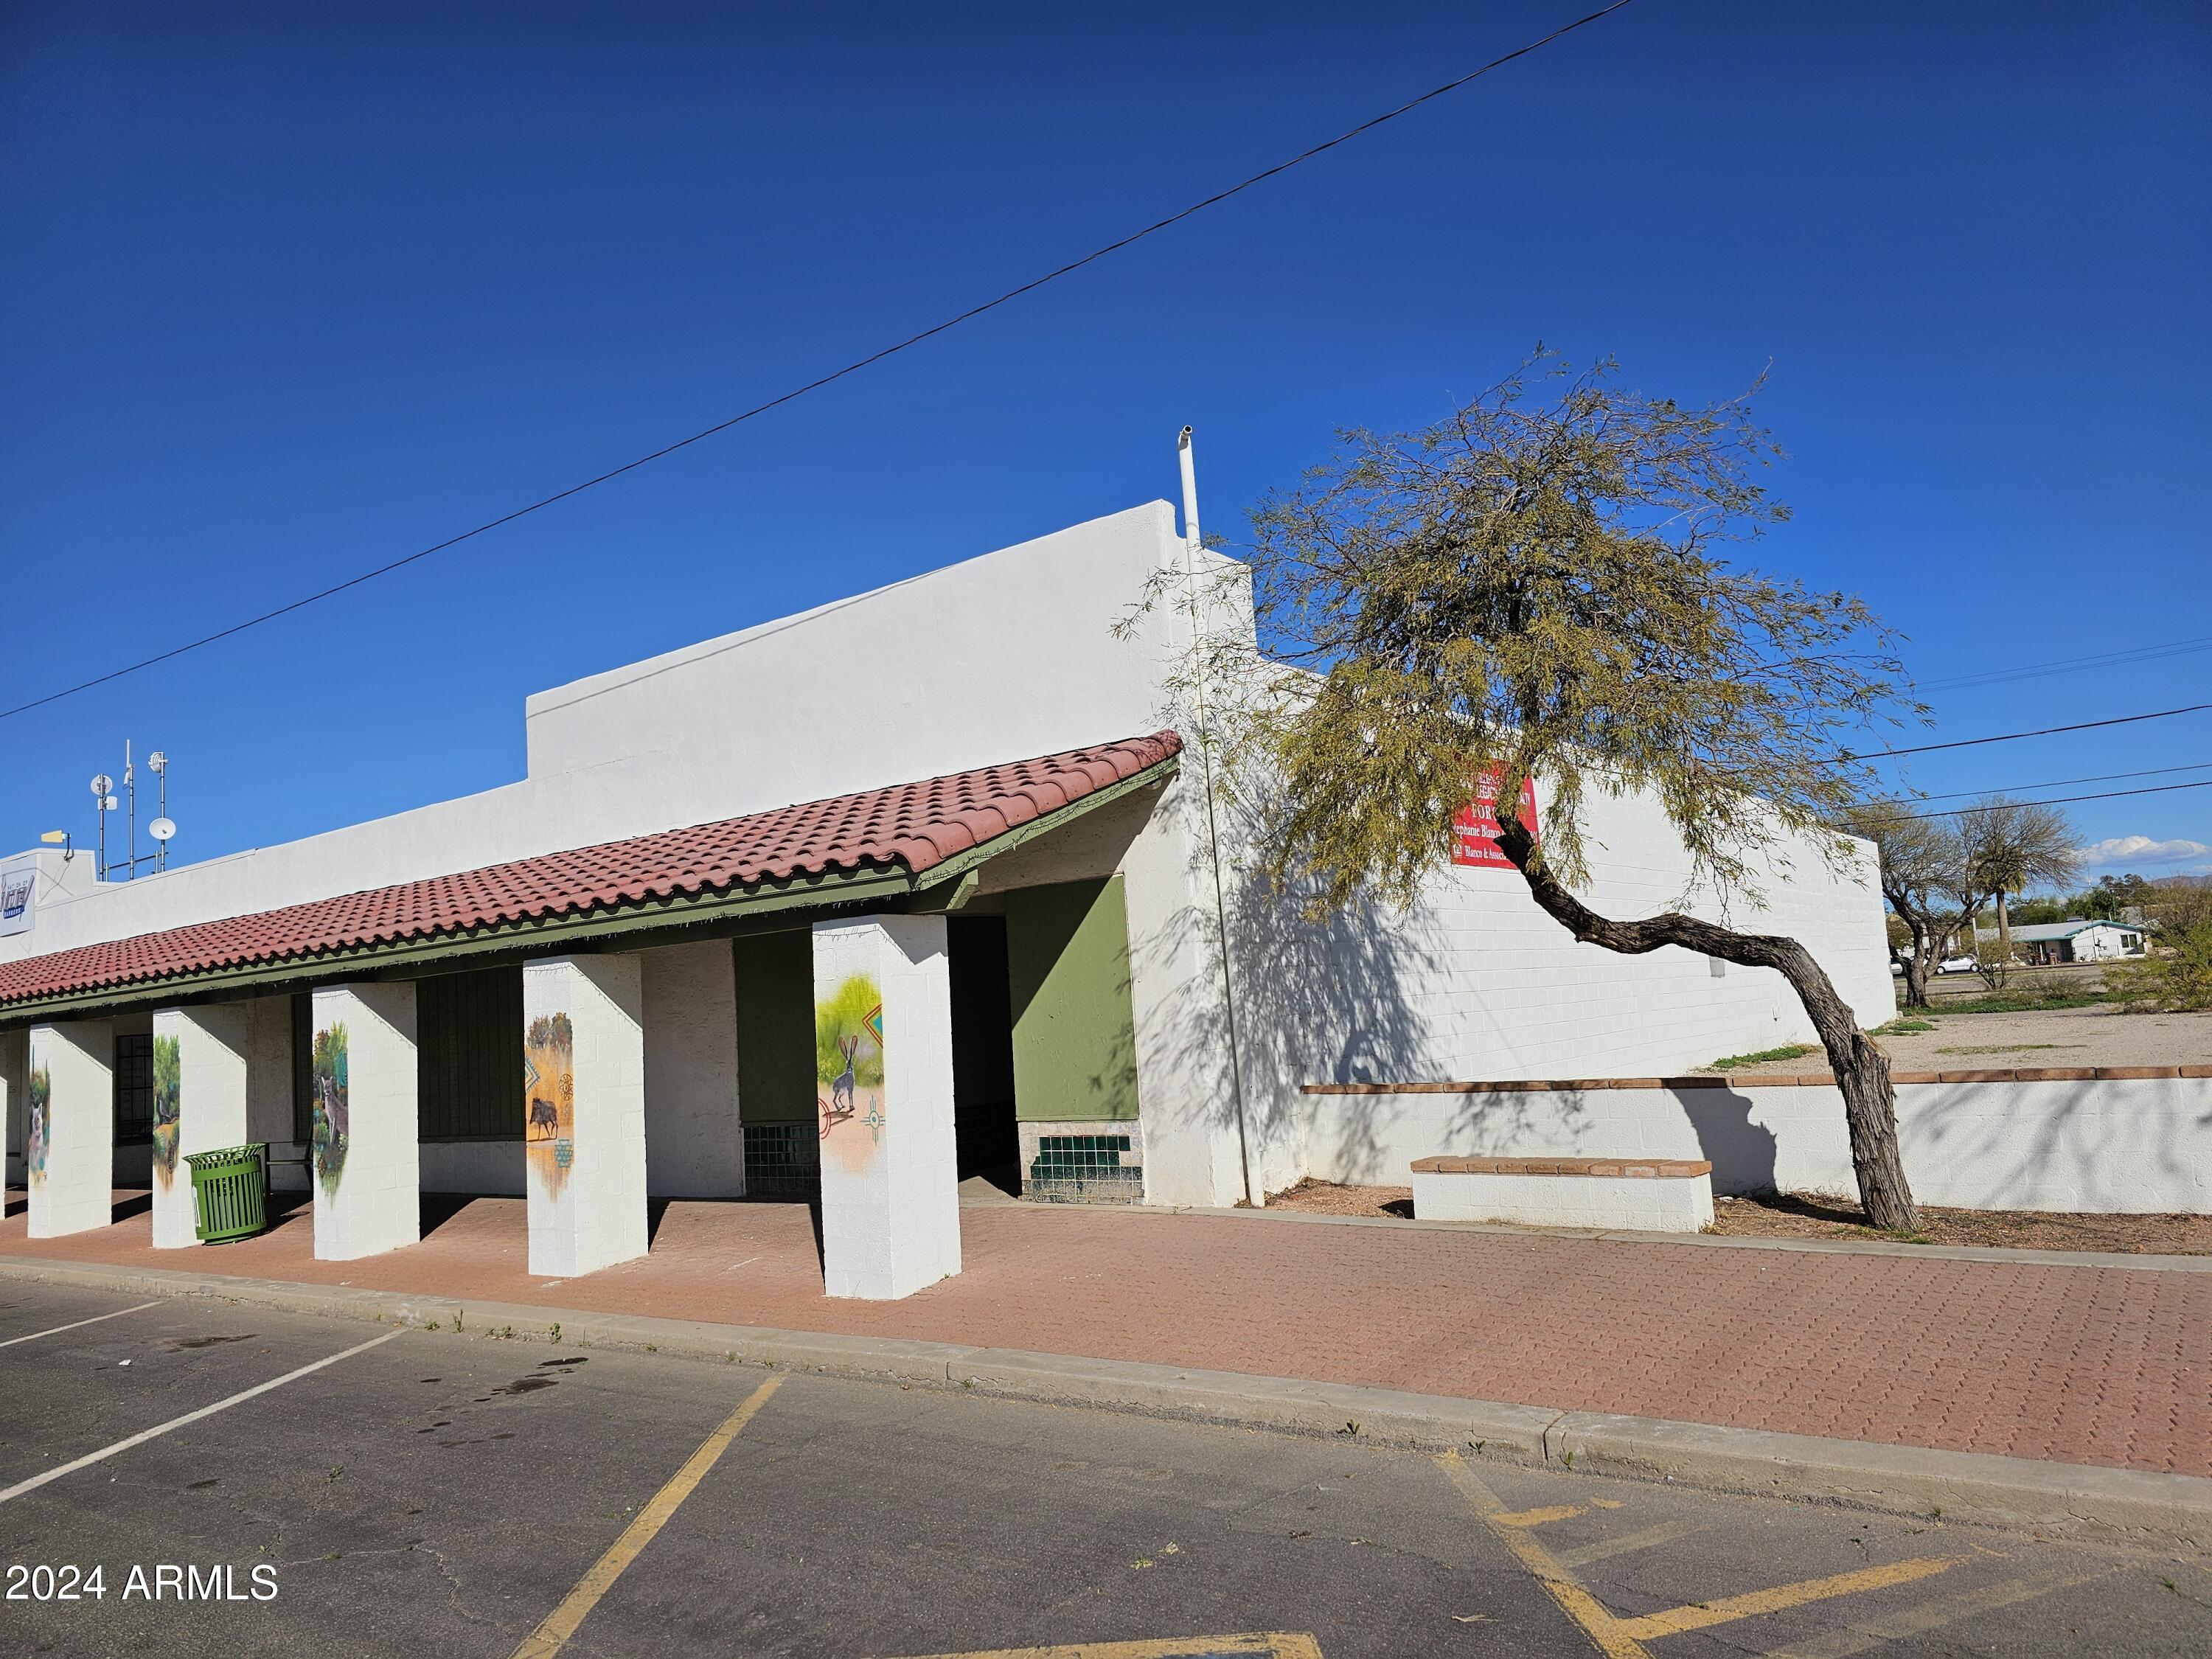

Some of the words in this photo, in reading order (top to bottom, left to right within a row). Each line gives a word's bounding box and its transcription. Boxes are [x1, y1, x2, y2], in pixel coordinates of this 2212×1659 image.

[1471, 804, 1492, 820] FOR
[1453, 822, 1480, 839] tephanie
[1481, 824, 1500, 838] Blanco
[1464, 845, 1483, 858] Blanco
[1484, 847, 1489, 859] &
